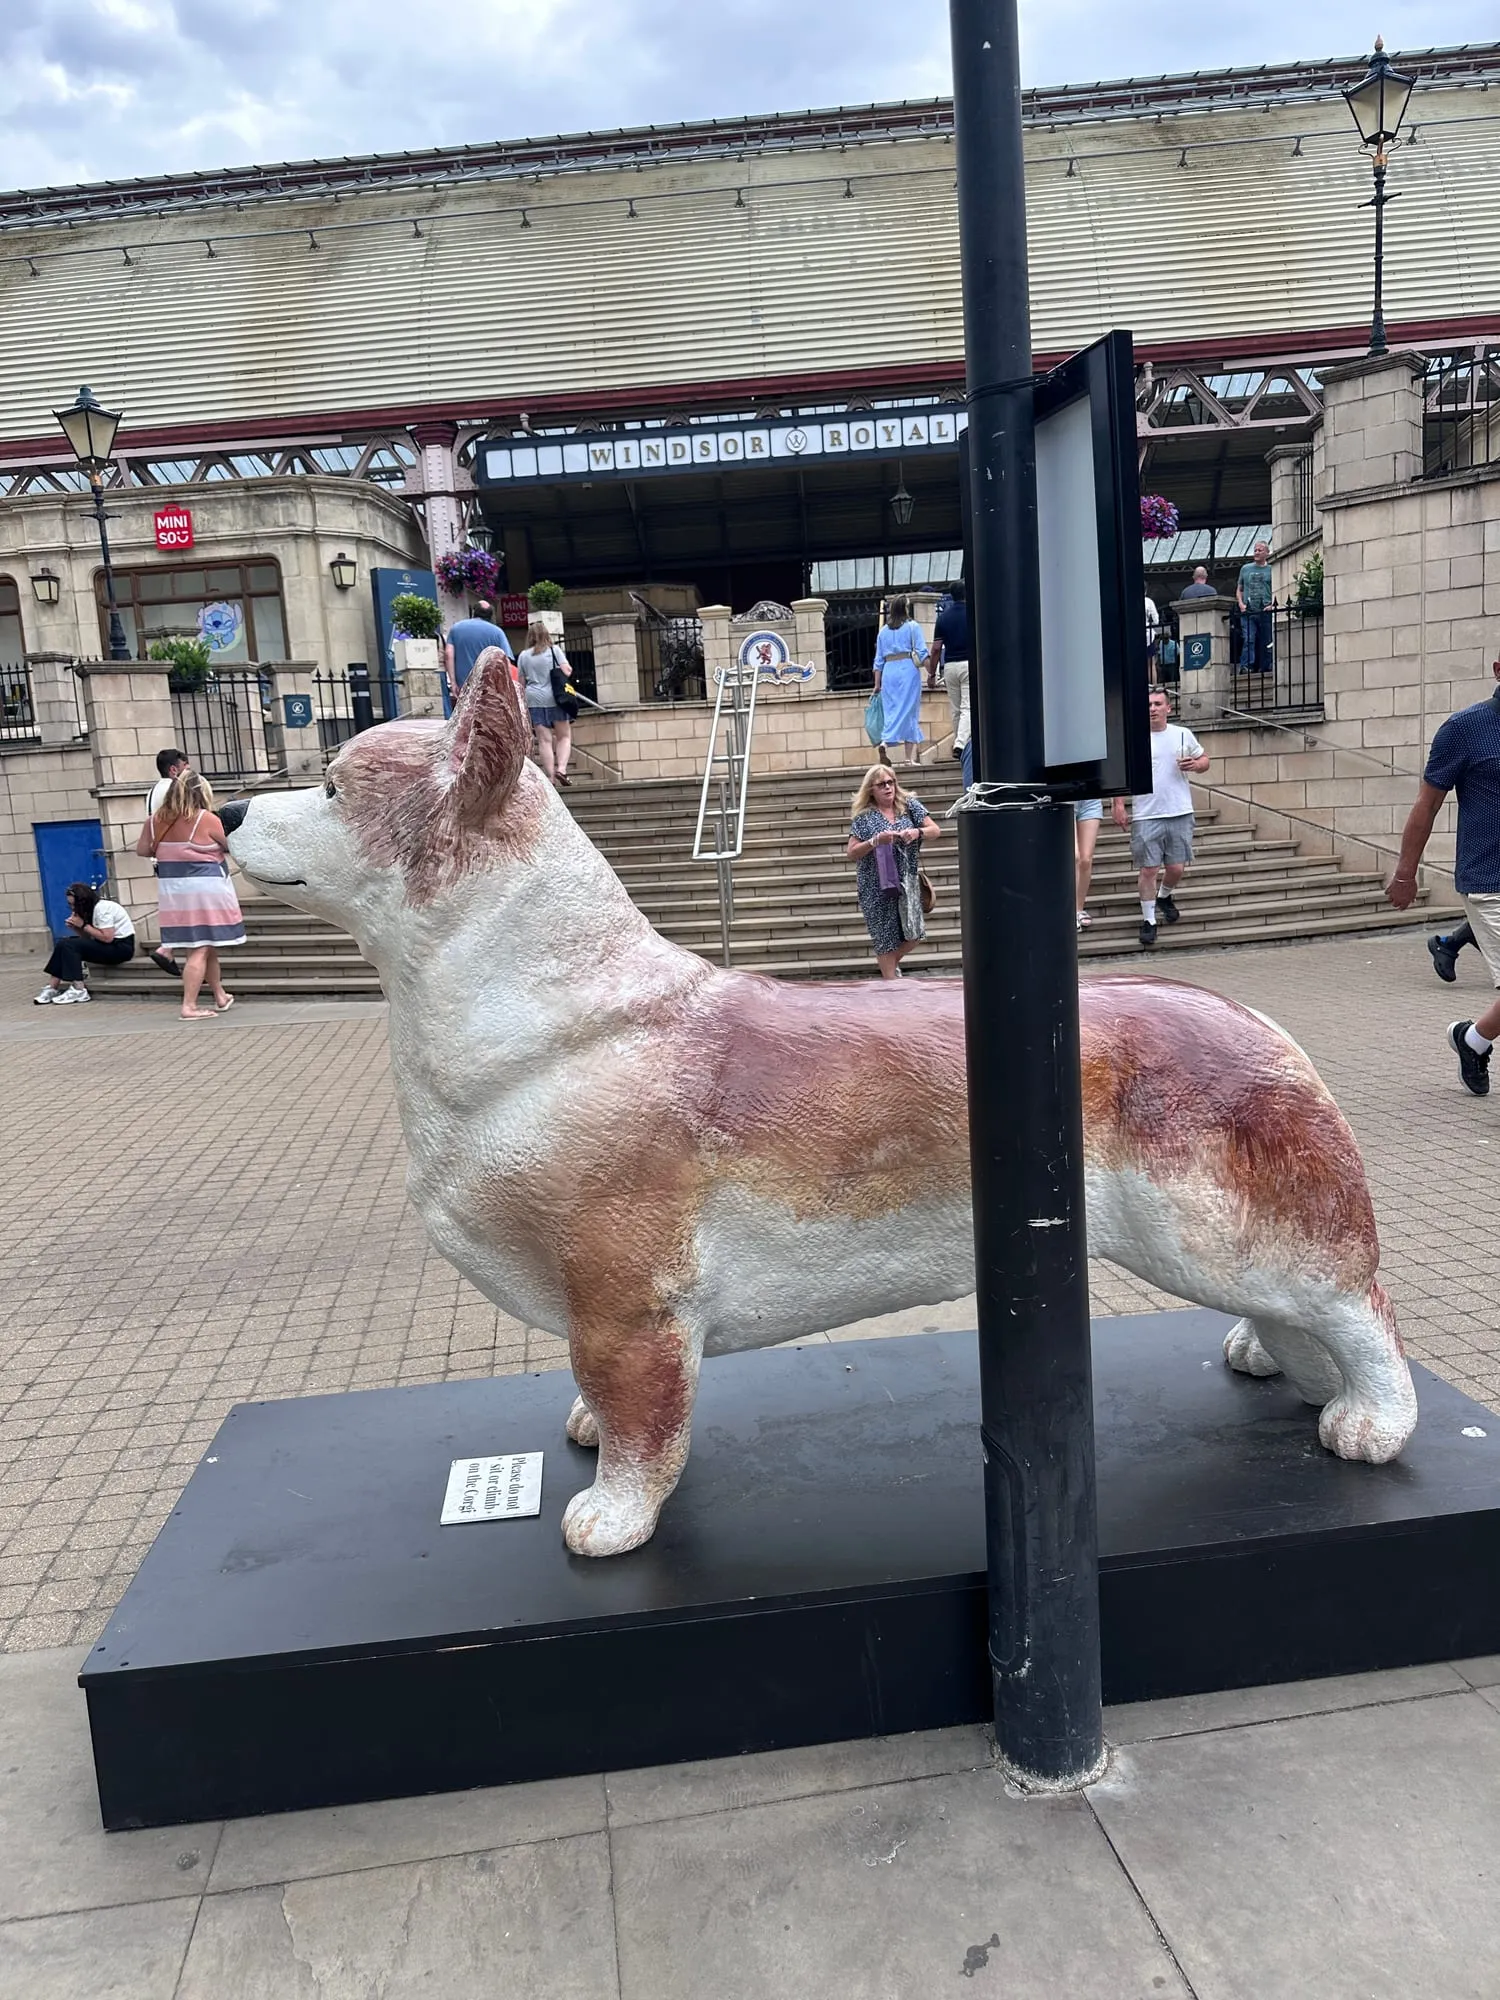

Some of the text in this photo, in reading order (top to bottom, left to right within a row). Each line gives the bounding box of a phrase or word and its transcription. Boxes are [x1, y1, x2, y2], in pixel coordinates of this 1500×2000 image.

[590, 436, 764, 466] WINDSOR
[829, 420, 949, 447] ROYAL
[157, 515, 188, 529] MINI
[503, 601, 526, 611] MINI
[458, 1463, 482, 1513] on the Corgi
[484, 1464, 504, 1509] sit or climb
[507, 1457, 527, 1511] Please do not
